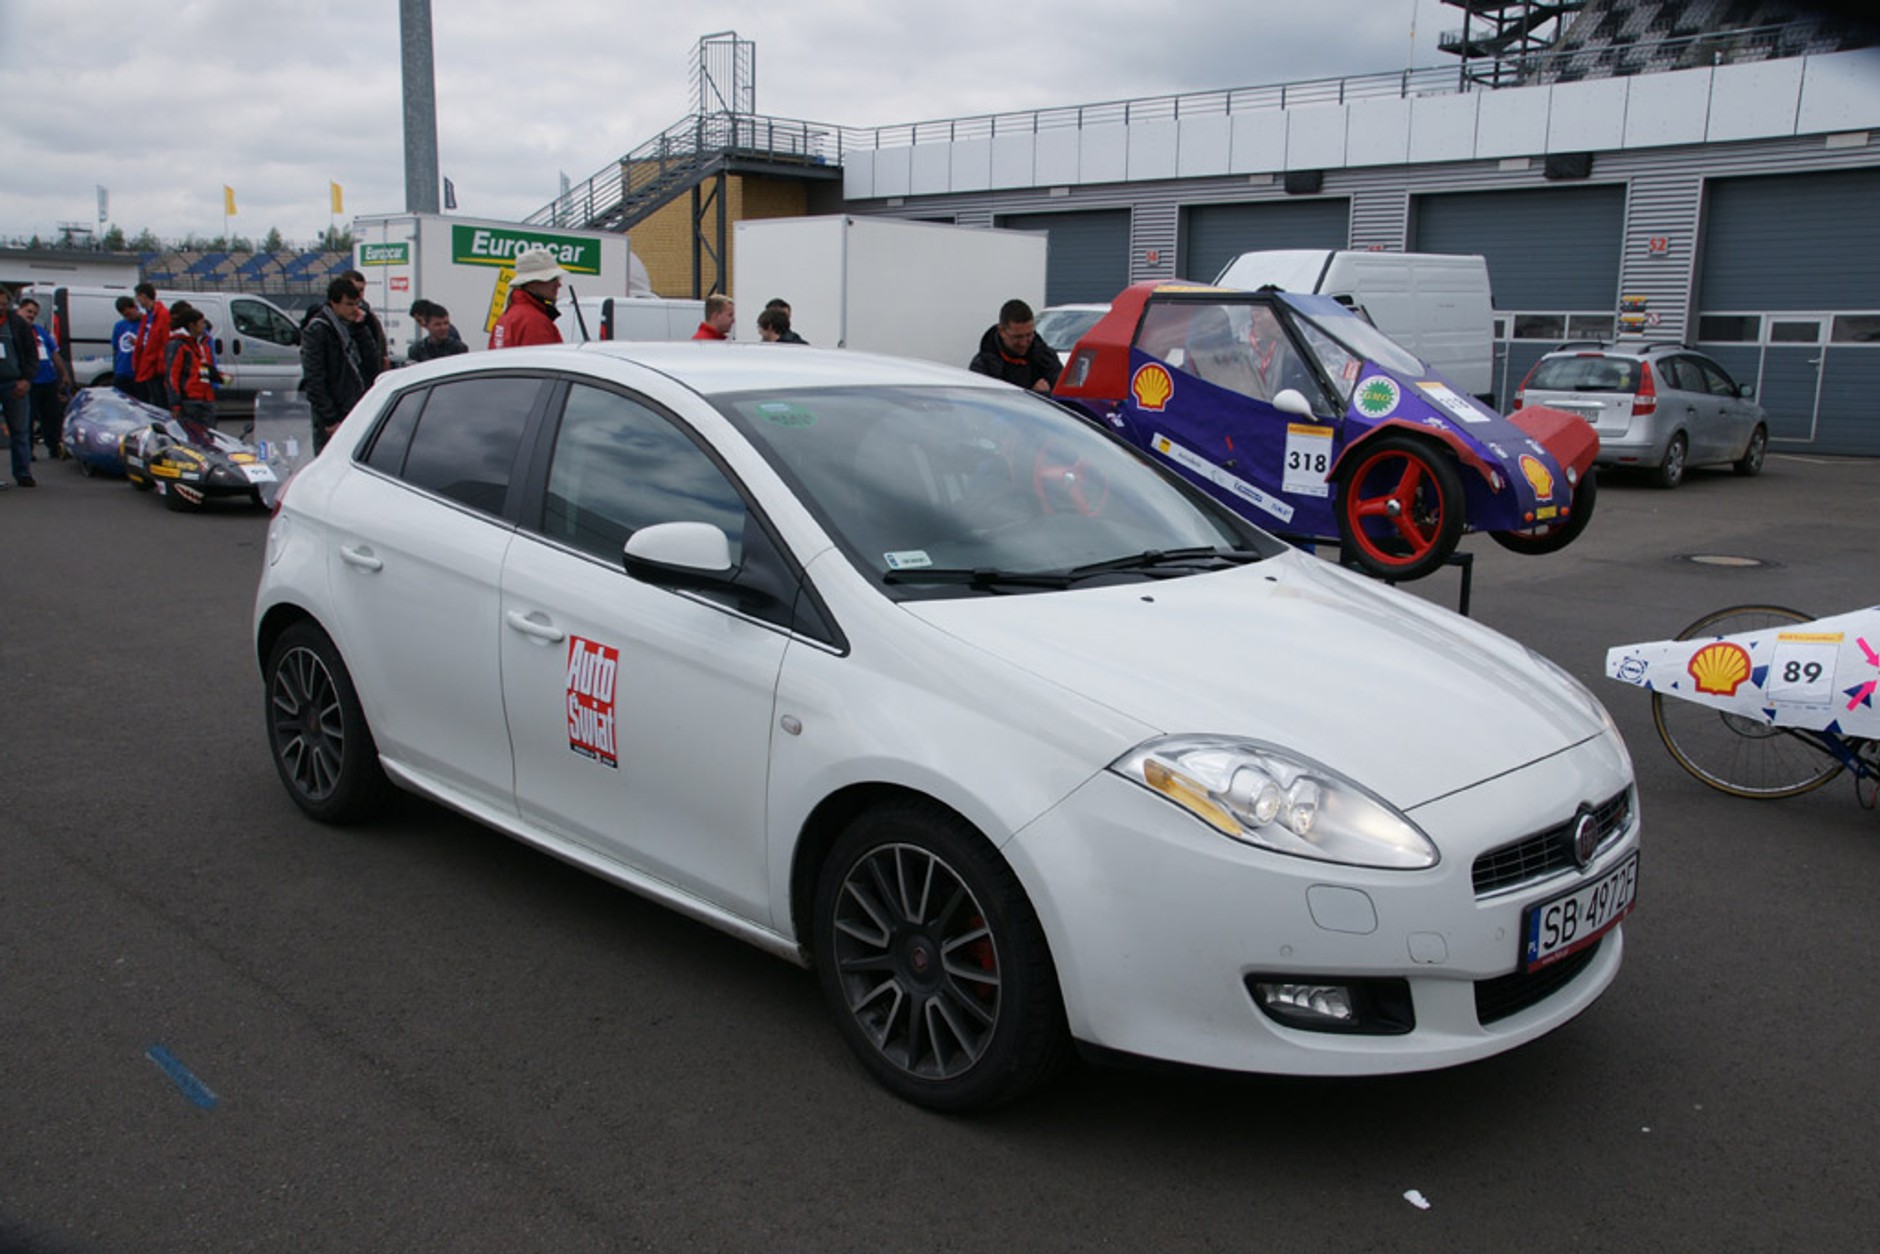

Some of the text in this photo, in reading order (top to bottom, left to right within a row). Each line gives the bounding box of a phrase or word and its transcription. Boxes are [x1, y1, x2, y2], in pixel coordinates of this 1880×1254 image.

[1649, 237, 1667, 252] 52
[1288, 451, 1327, 473] 318
[565, 639, 616, 703] Auto
[1783, 661, 1822, 684] 89
[1543, 898, 1578, 950] SB
